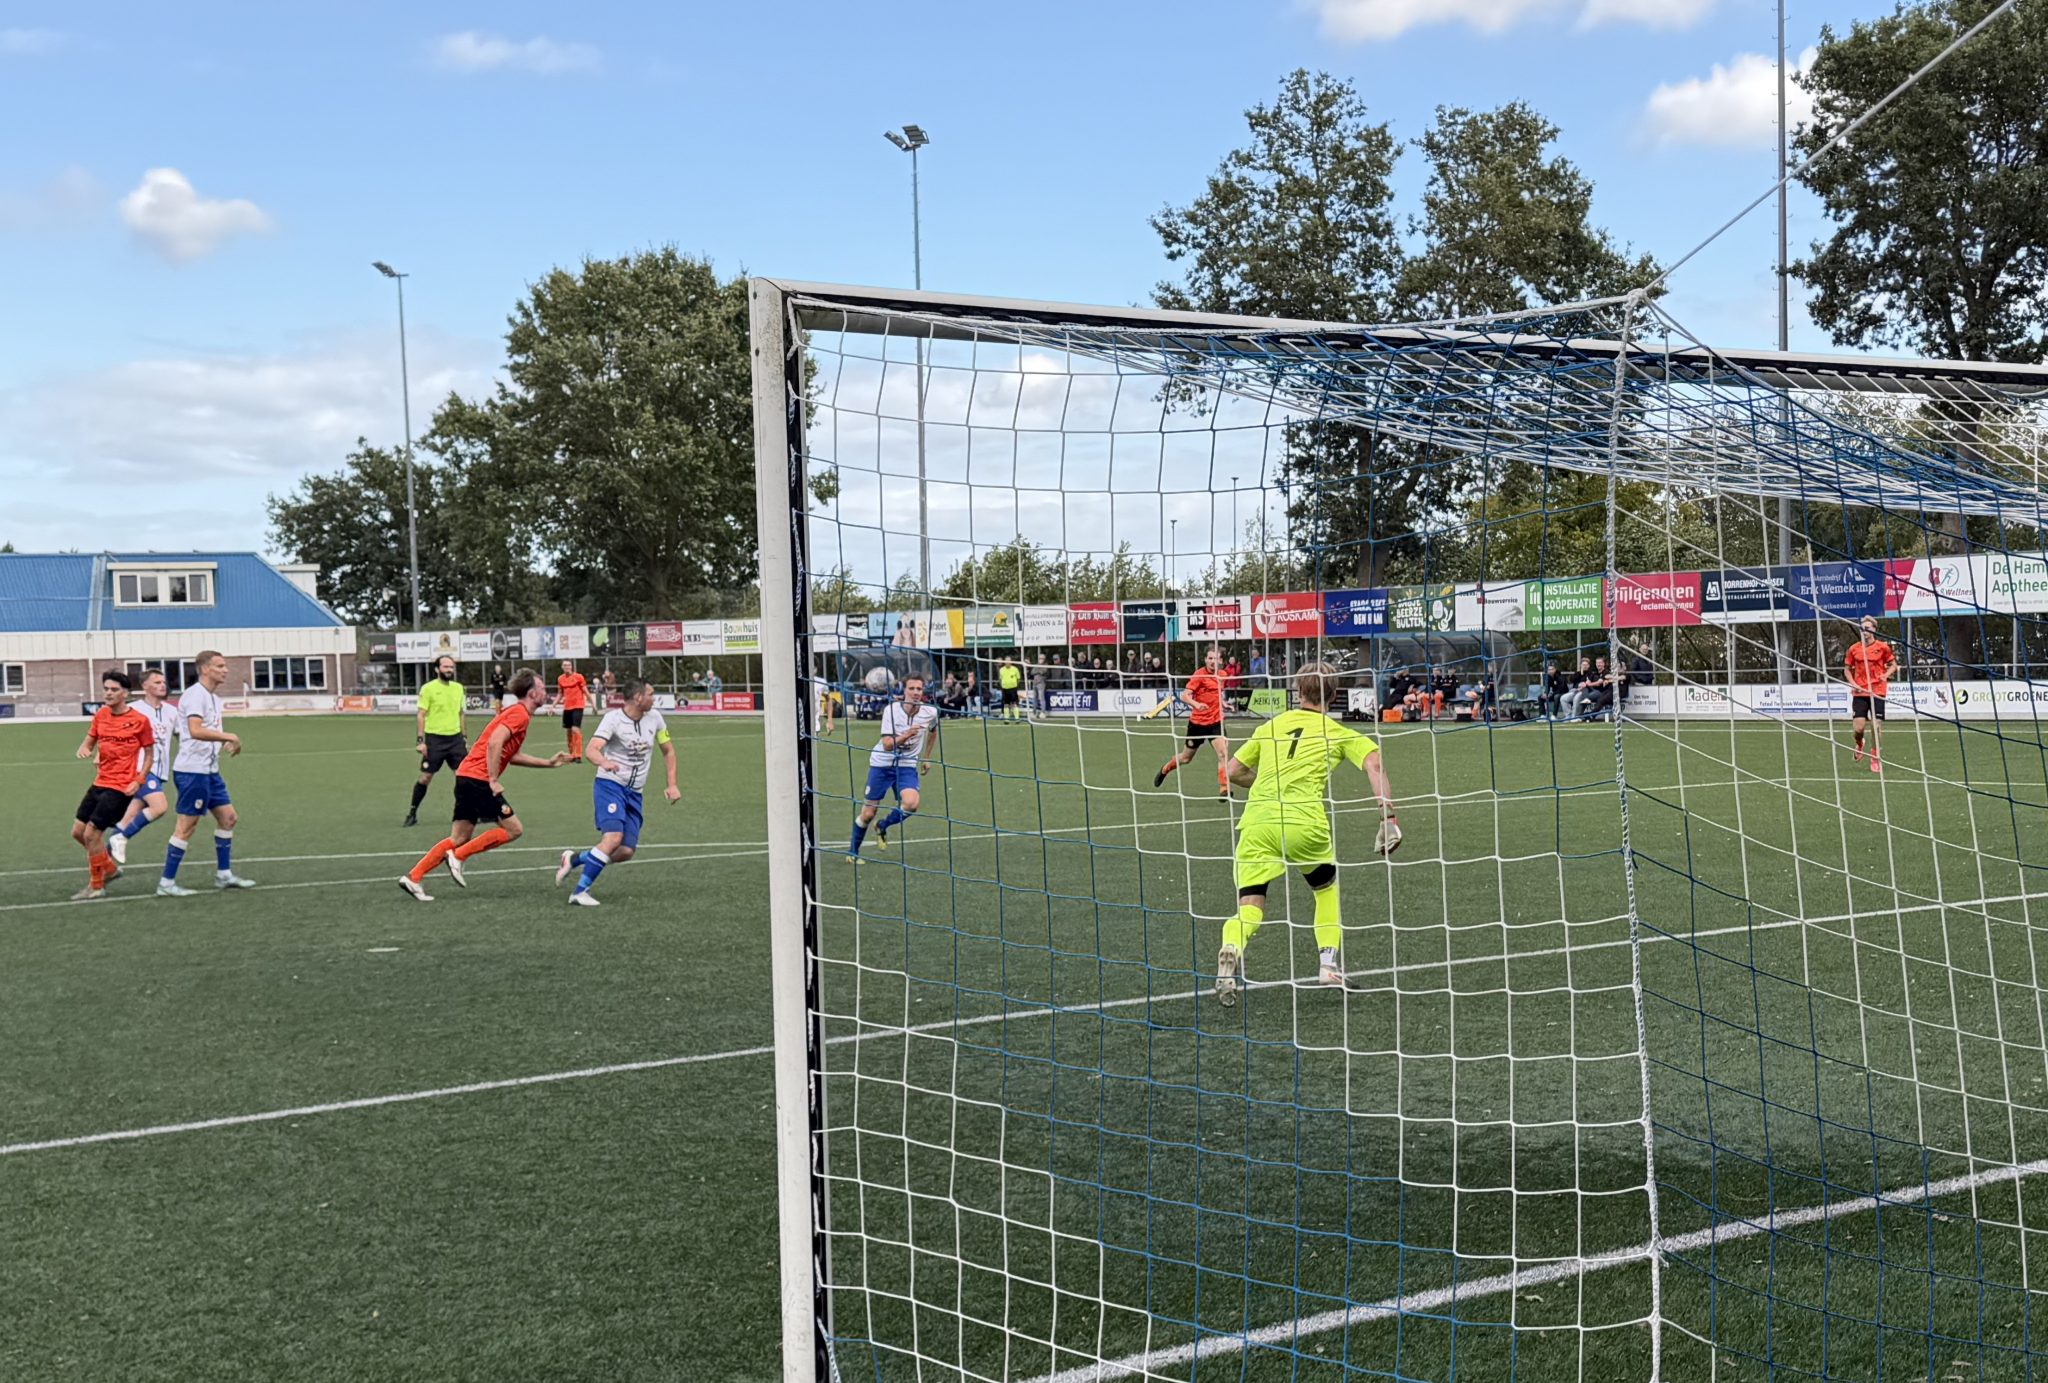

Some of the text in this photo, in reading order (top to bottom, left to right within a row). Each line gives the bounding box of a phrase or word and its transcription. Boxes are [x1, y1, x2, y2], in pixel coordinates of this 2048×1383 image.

[1993, 561, 2009, 576] De
[1543, 583, 1597, 596] INSTALLATIE
[1606, 585, 1694, 605] tijlgenoten
[1800, 584, 1819, 595] Erk
[1945, 588, 1975, 597] Wellnes
[1543, 597, 1597, 610] COÖPERATIE
[1640, 602, 1694, 611] reclamebreau
[1189, 609, 1205, 626] MS
[1573, 614, 1595, 624] BEZIG
[1888, 685, 1928, 693] RECLAMBORD
[1286, 727, 1305, 760] 1
